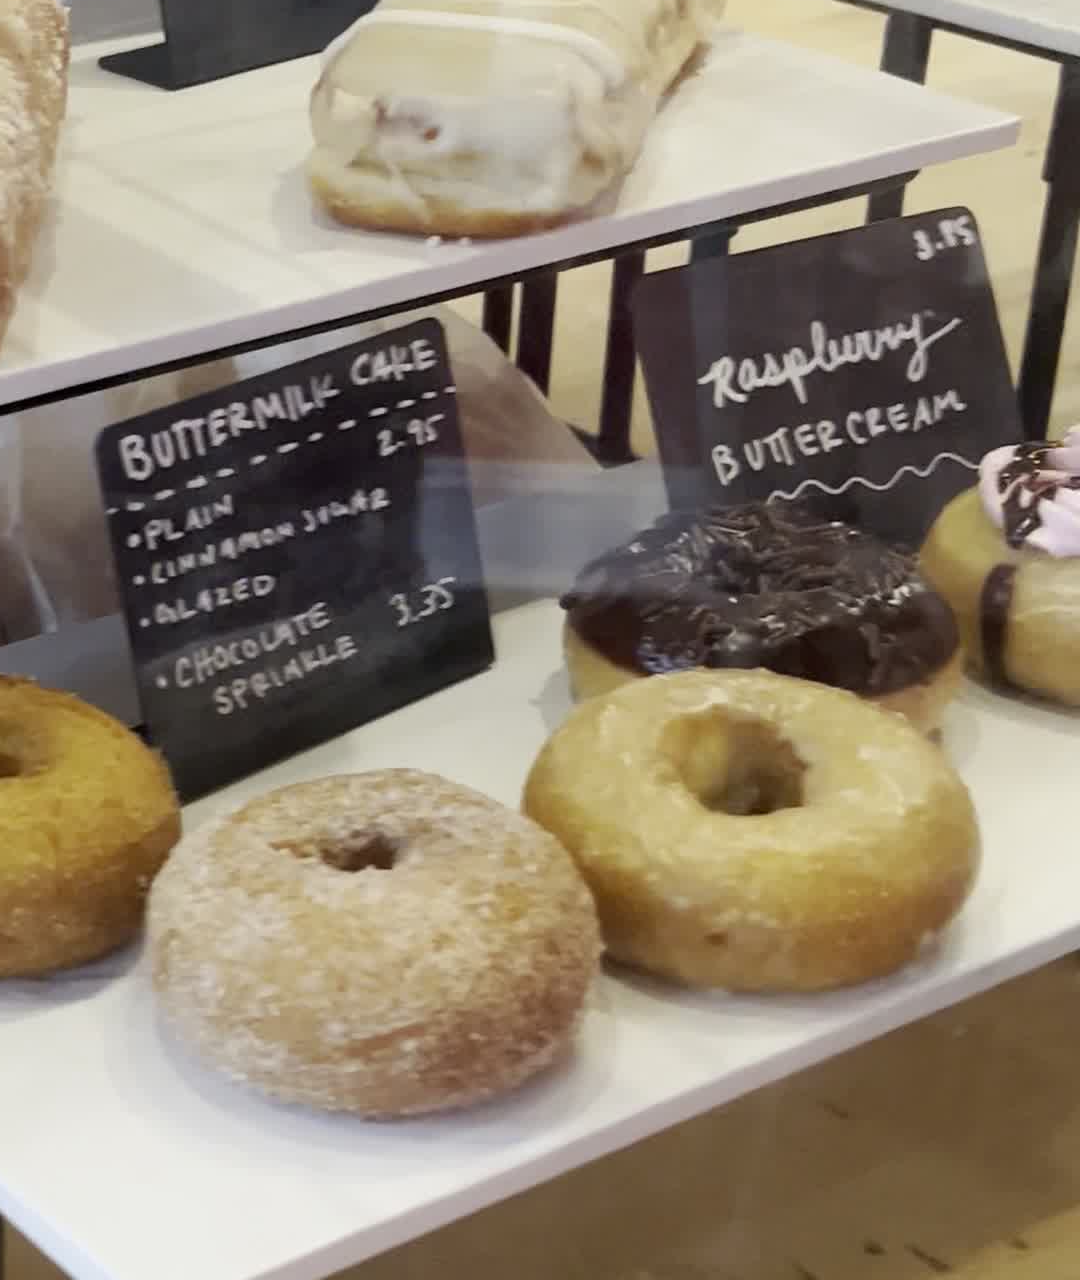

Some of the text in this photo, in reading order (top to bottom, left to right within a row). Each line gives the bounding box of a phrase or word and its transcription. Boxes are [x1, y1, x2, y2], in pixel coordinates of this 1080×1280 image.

[121, 338, 438, 480] BUTTERMILK CAKE
[711, 388, 968, 487] BUTTERCREAM
[143, 493, 234, 551] PLAIN
[150, 521, 296, 586] CINNAMON
[173, 601, 333, 690] CHOCOLATE
[211, 634, 358, 716] SPRINKLE
